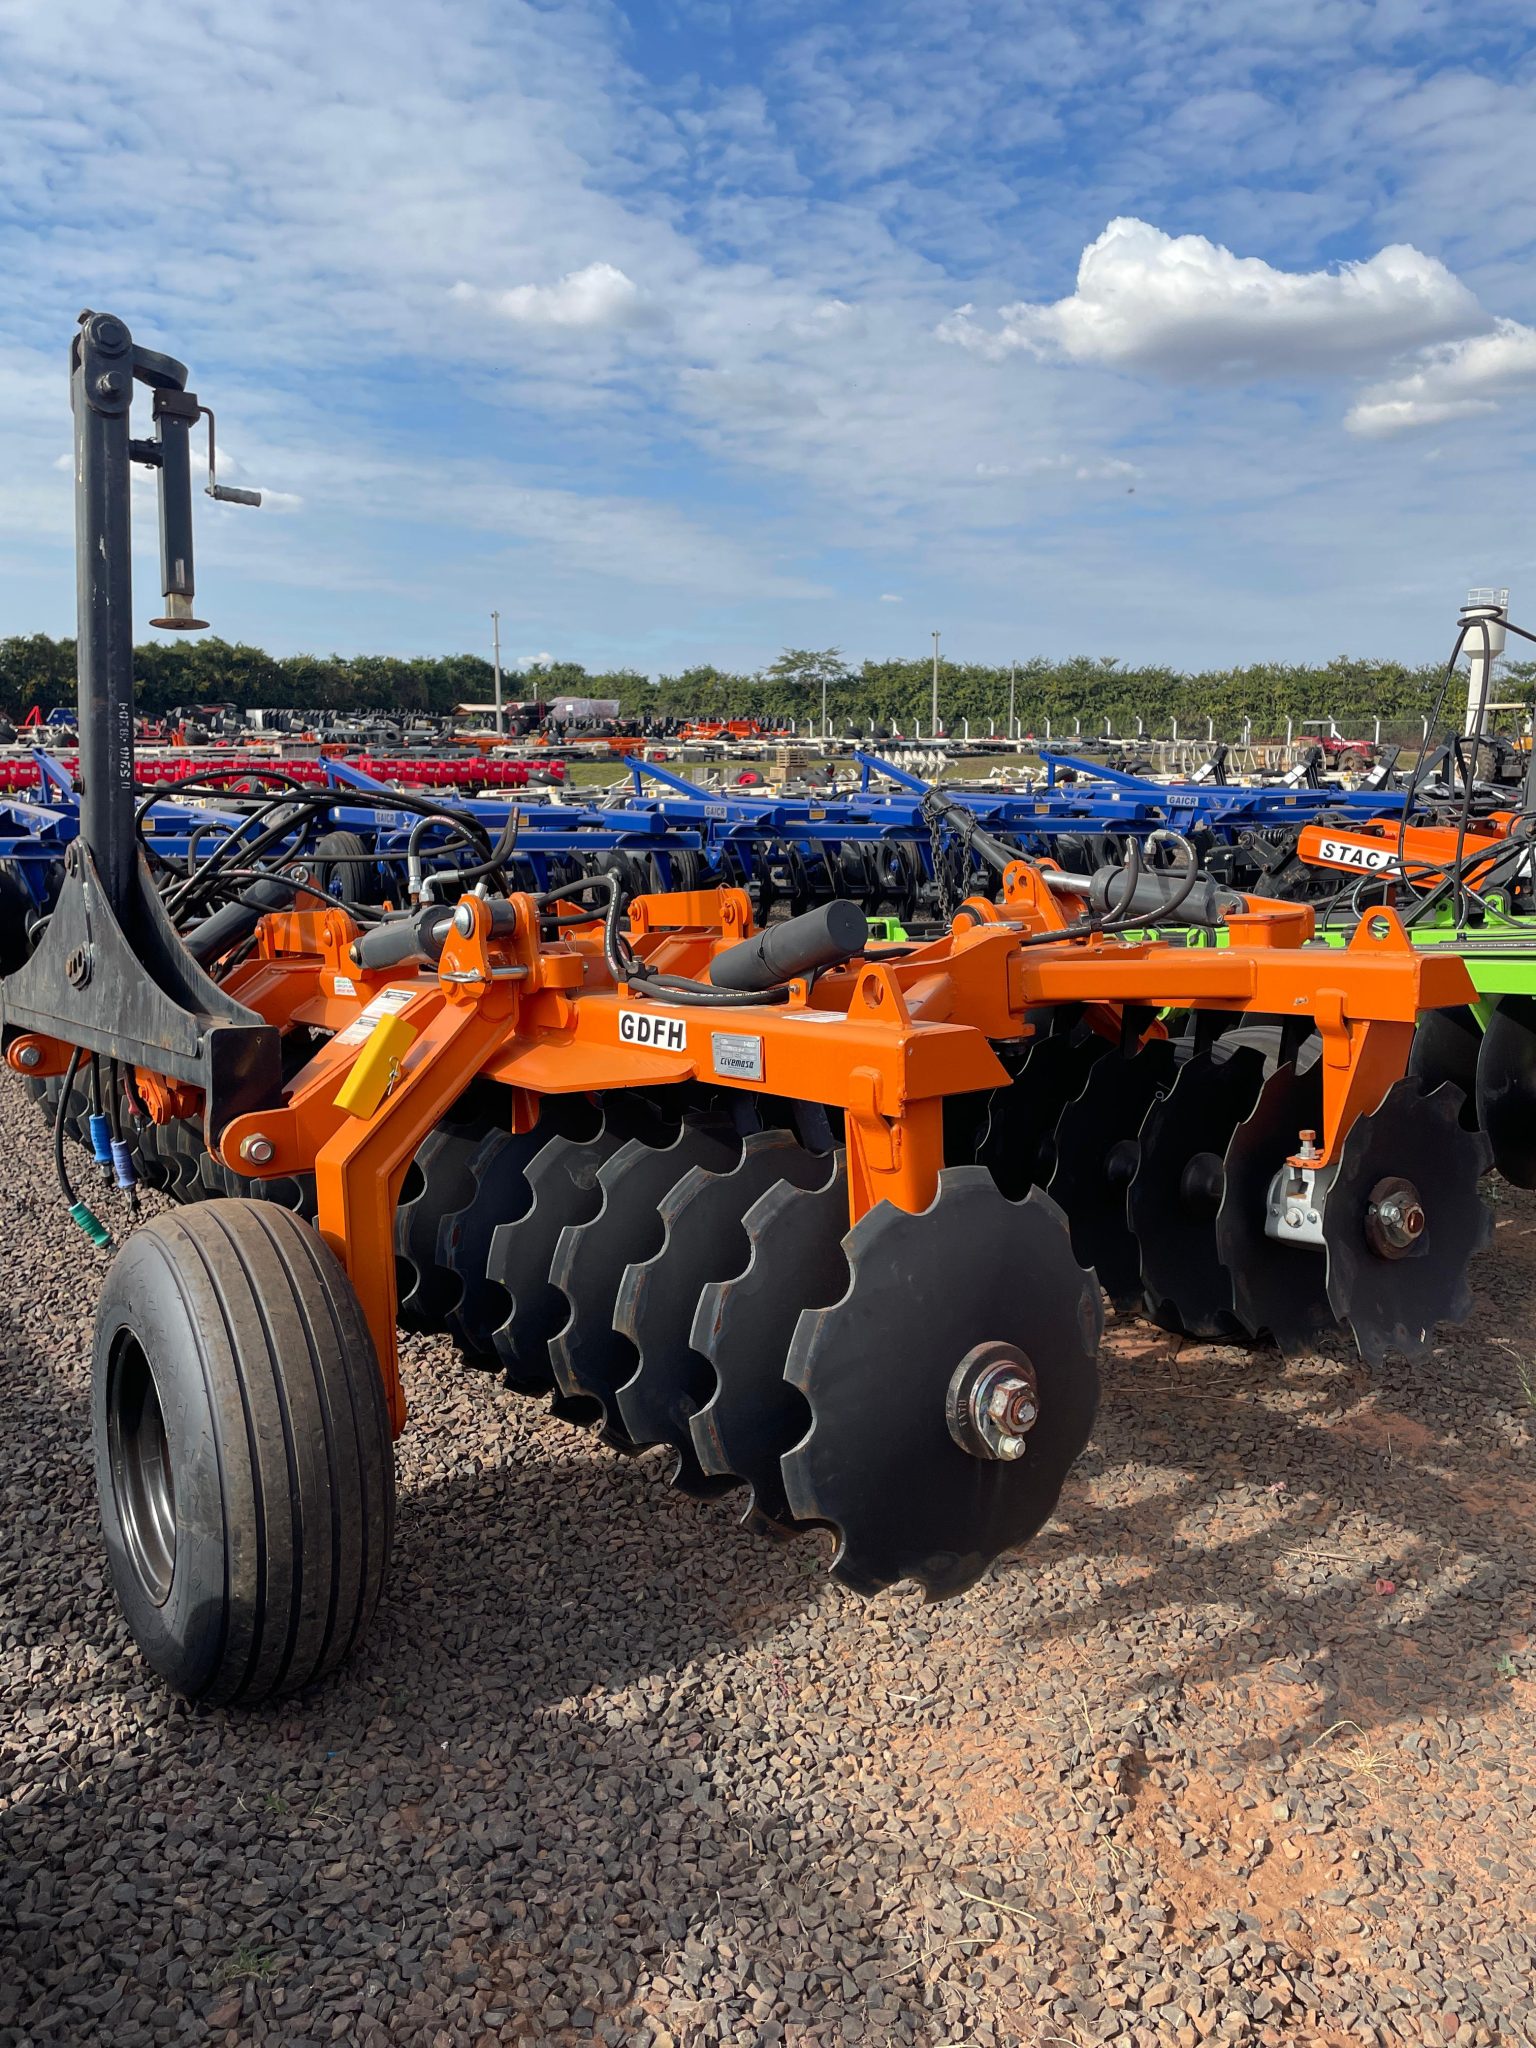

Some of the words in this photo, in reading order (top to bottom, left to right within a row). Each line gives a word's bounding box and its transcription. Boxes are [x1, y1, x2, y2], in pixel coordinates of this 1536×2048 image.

[1169, 796, 1197, 806] GAICR
[706, 806, 725, 817] GAICR
[1323, 843, 1380, 867] STAC
[621, 1014, 684, 1049] GDFH
